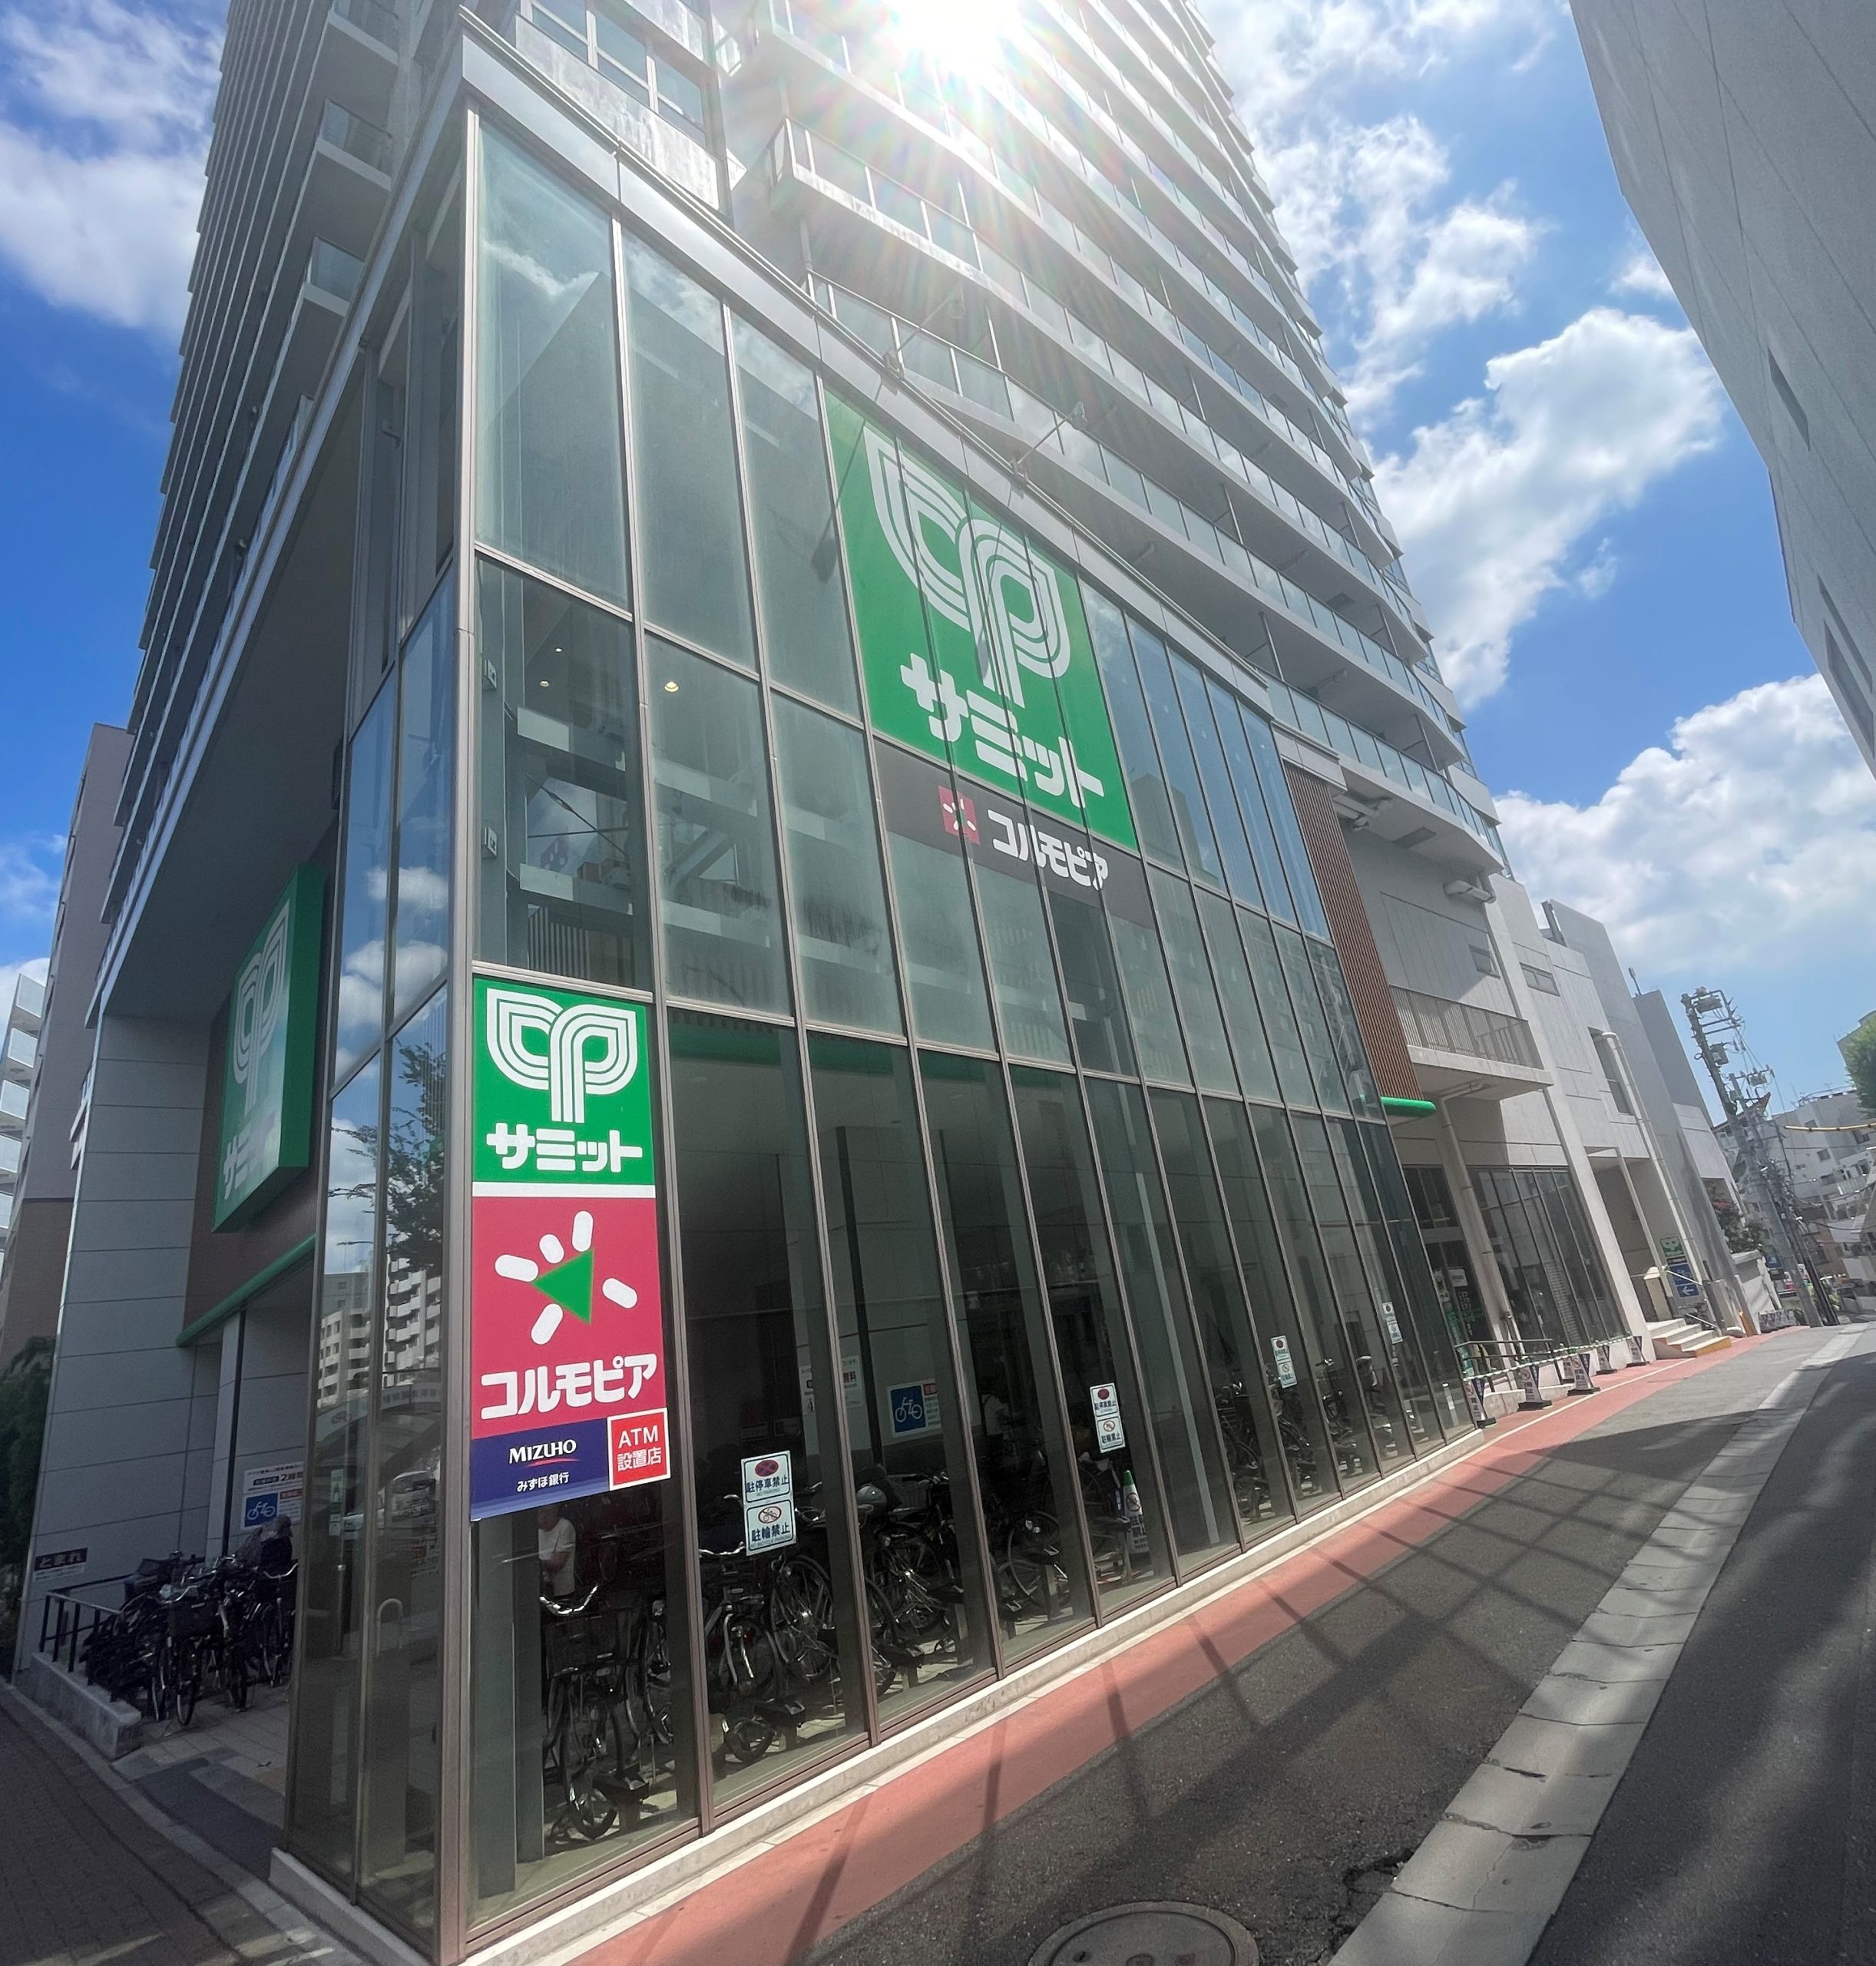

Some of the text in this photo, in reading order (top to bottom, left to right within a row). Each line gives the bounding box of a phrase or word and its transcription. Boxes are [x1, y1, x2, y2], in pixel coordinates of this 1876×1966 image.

[900, 652, 1104, 809] サミット
[988, 808, 1108, 892] コルモピア
[485, 1122, 643, 1173] サミット
[481, 1353, 657, 1420] コルモピア
[618, 1425, 659, 1449] ATM
[508, 1439, 577, 1465] MIZUHO
[617, 1447, 662, 1472] 設置店
[517, 1471, 570, 1493] みずほ銀行
[746, 1474, 789, 1493] 駐停車禁止
[751, 1521, 790, 1542] 駐輪禁止
[39, 1551, 81, 1568] とまれ
